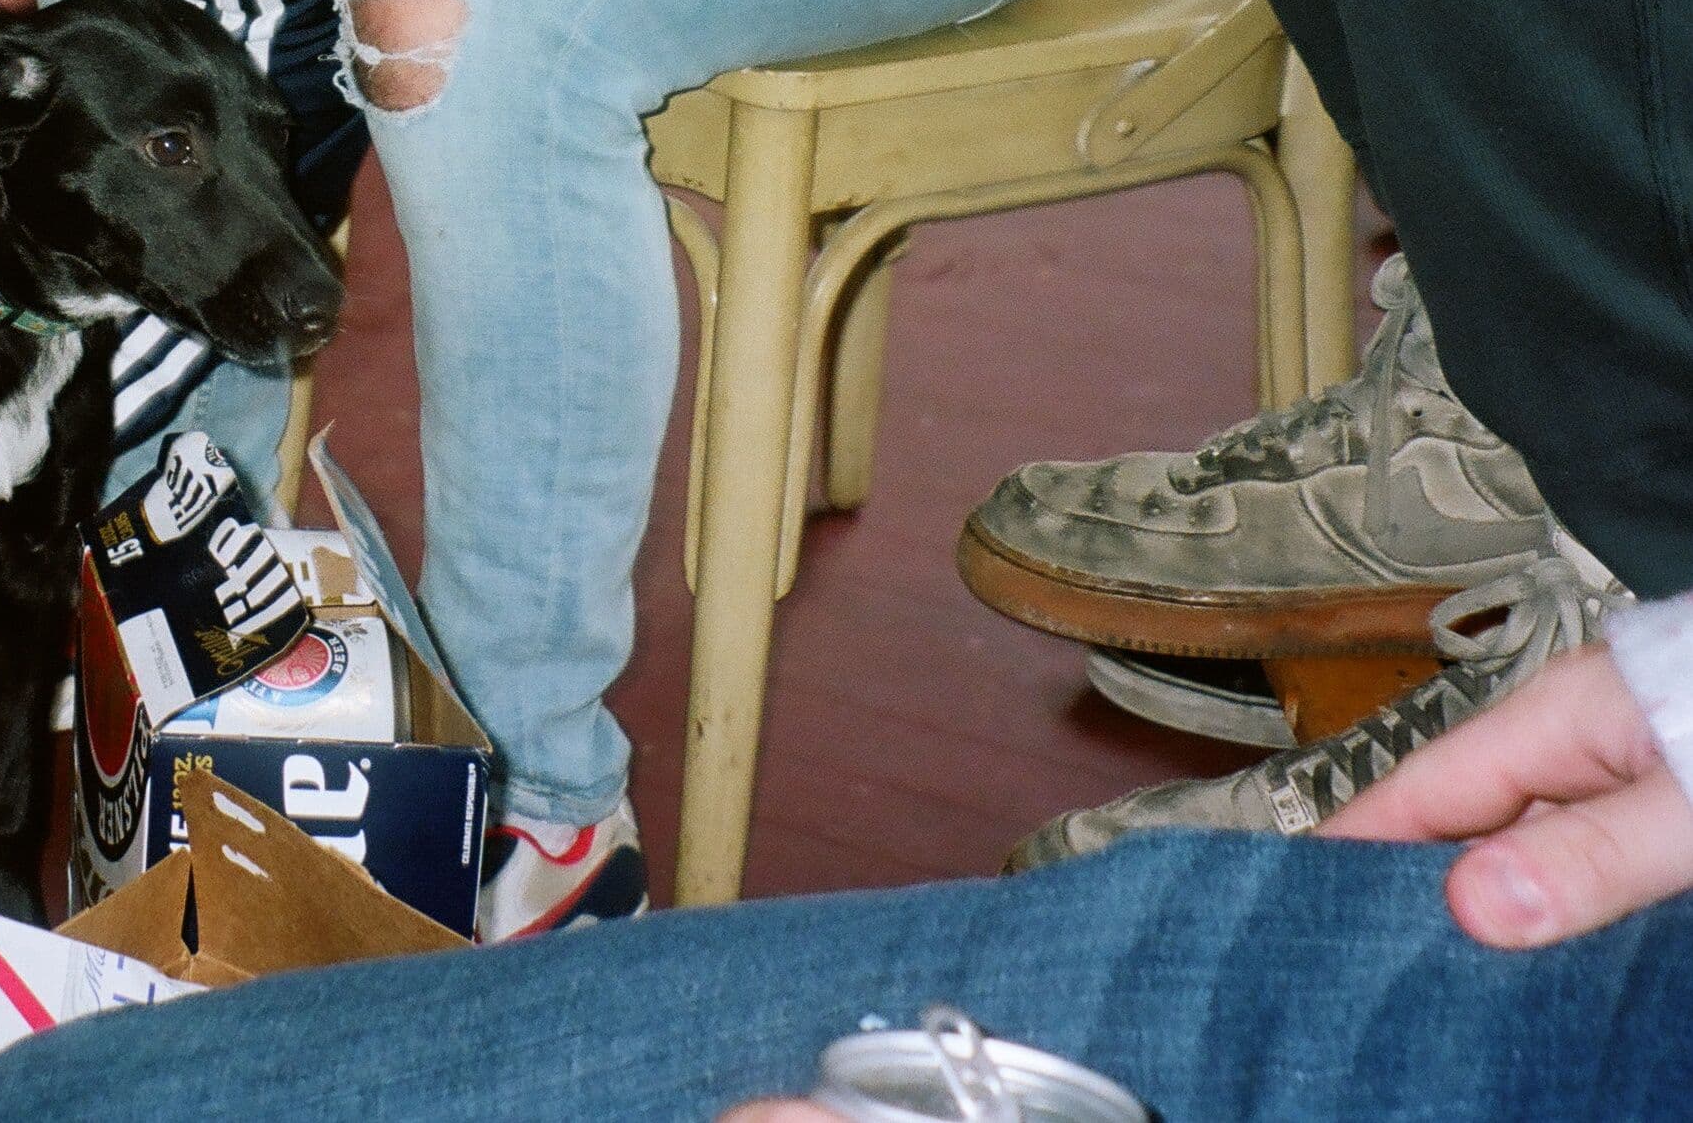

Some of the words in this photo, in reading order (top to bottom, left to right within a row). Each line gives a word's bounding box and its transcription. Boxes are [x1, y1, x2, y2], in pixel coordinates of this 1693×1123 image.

[107, 538, 143, 565] 15
[327, 637, 344, 673] BEER
[98, 710, 148, 845] PILSNER
[461, 822, 472, 865] CELEBRATE
